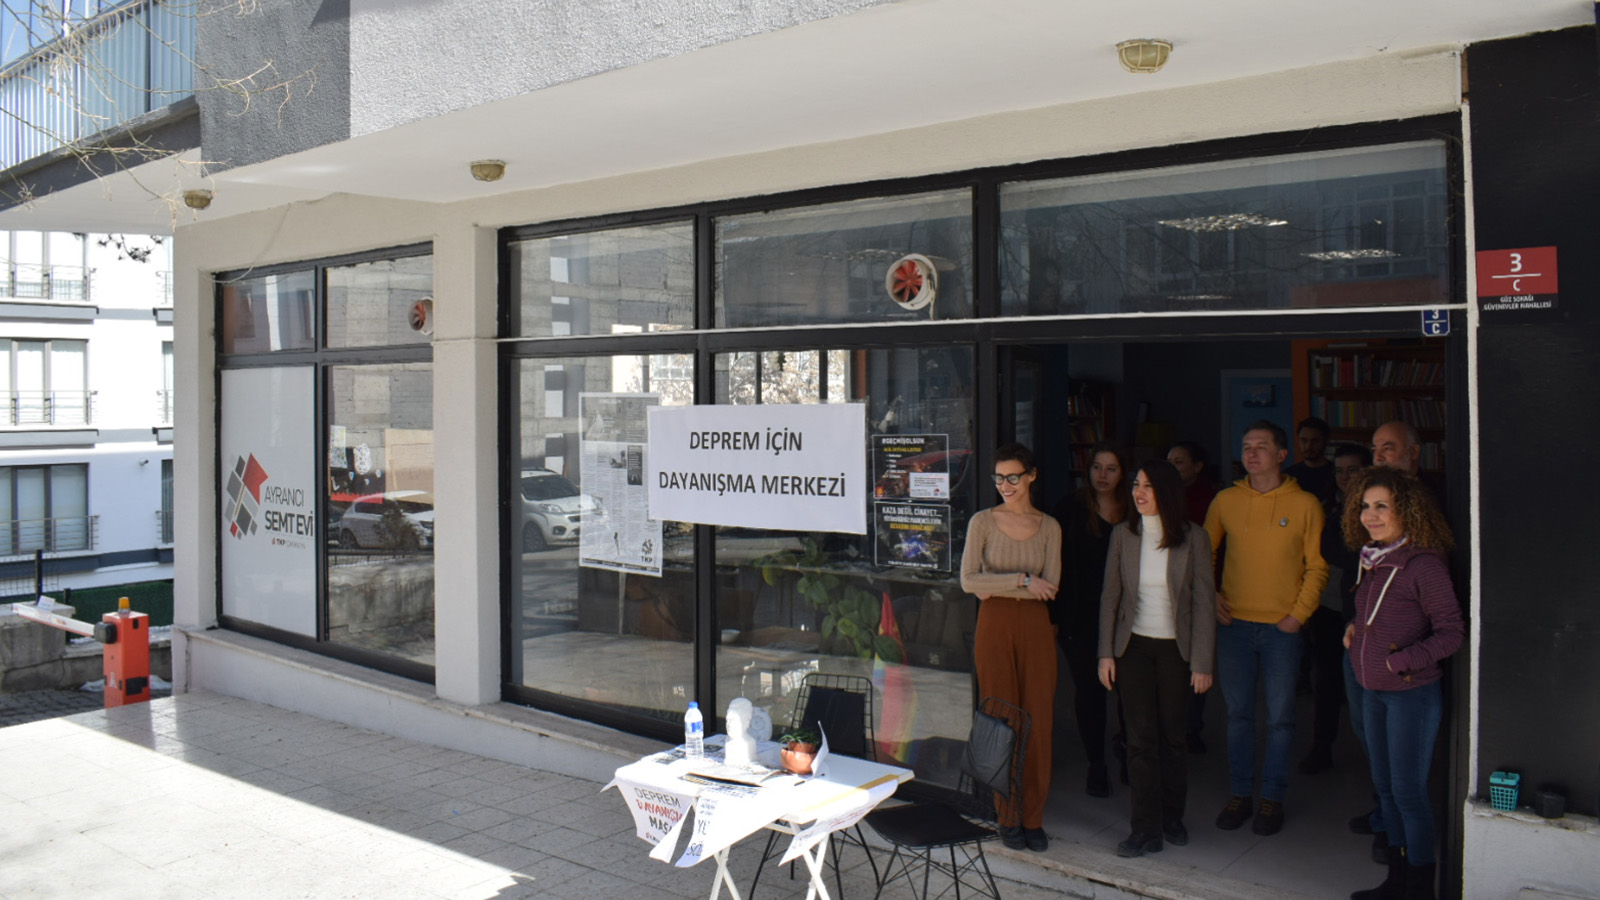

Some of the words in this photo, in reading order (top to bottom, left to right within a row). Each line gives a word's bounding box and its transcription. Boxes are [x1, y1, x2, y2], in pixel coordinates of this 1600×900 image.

[1510, 253, 1522, 272] 3
[1513, 279, 1521, 291] C
[1432, 309, 1438, 318] 3
[1432, 324, 1440, 334] C
[689, 431, 760, 450] DEPREM
[765, 427, 803, 456] İÇİN
[659, 471, 756, 496] DAYANIŞMA
[761, 472, 846, 497] MERKEZİ
[264, 486, 304, 507] AYRANCI
[265, 510, 295, 533] SEMT
[296, 510, 313, 536] EVİ
[634, 787, 682, 808] DEPREM
